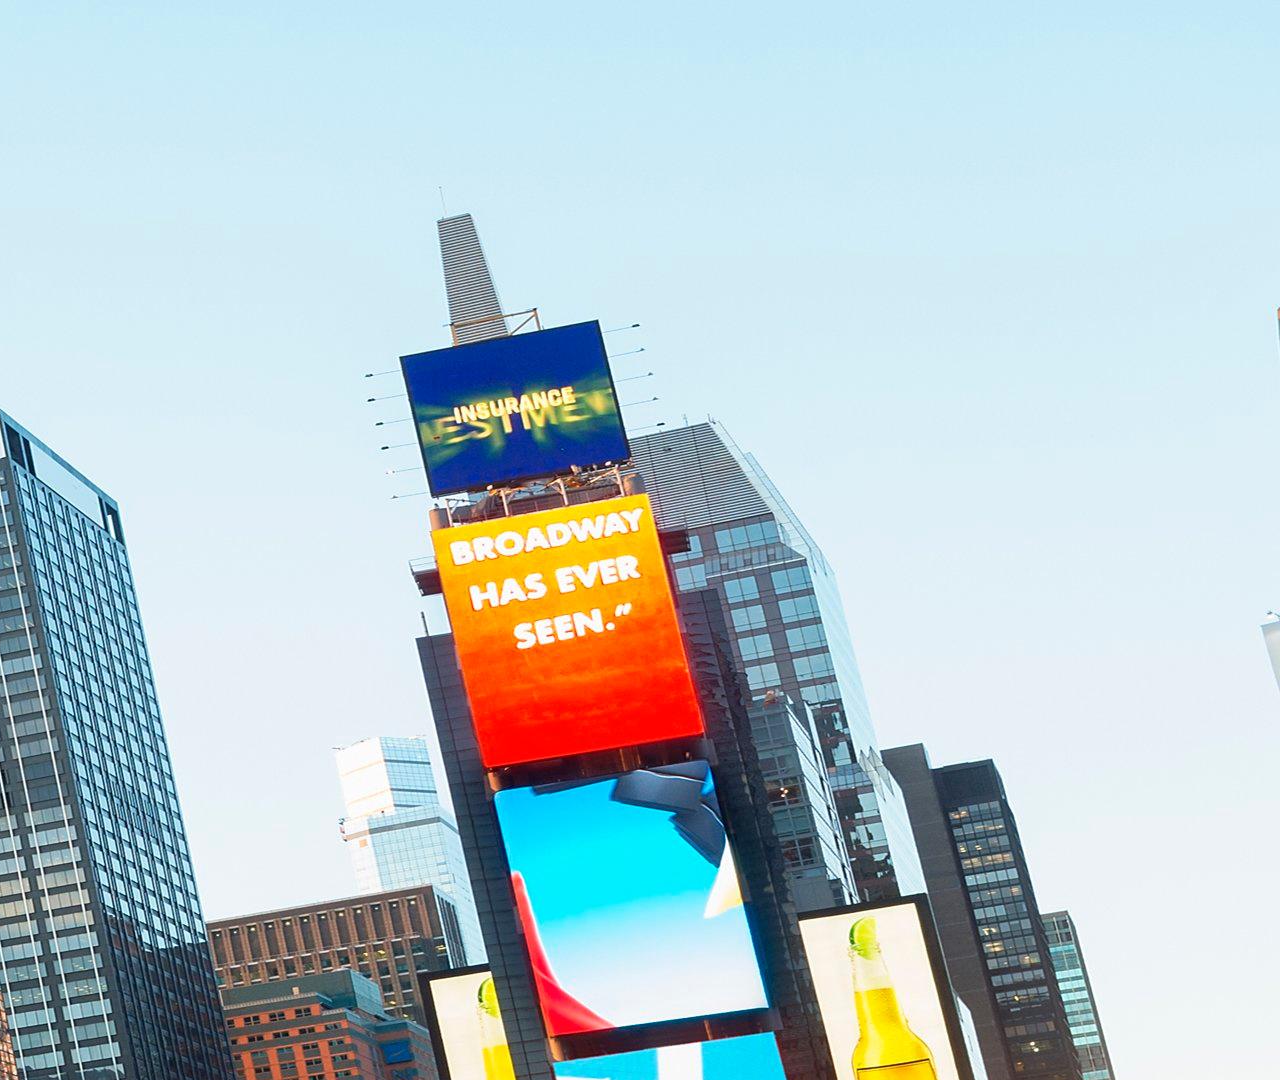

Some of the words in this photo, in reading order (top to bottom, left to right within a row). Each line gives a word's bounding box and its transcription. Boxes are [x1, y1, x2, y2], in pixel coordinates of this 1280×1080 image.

[453, 386, 577, 424] INSURANCE
[449, 507, 645, 566] BROADWAY
[469, 573, 548, 612] HAS
[555, 555, 641, 594] EVER
